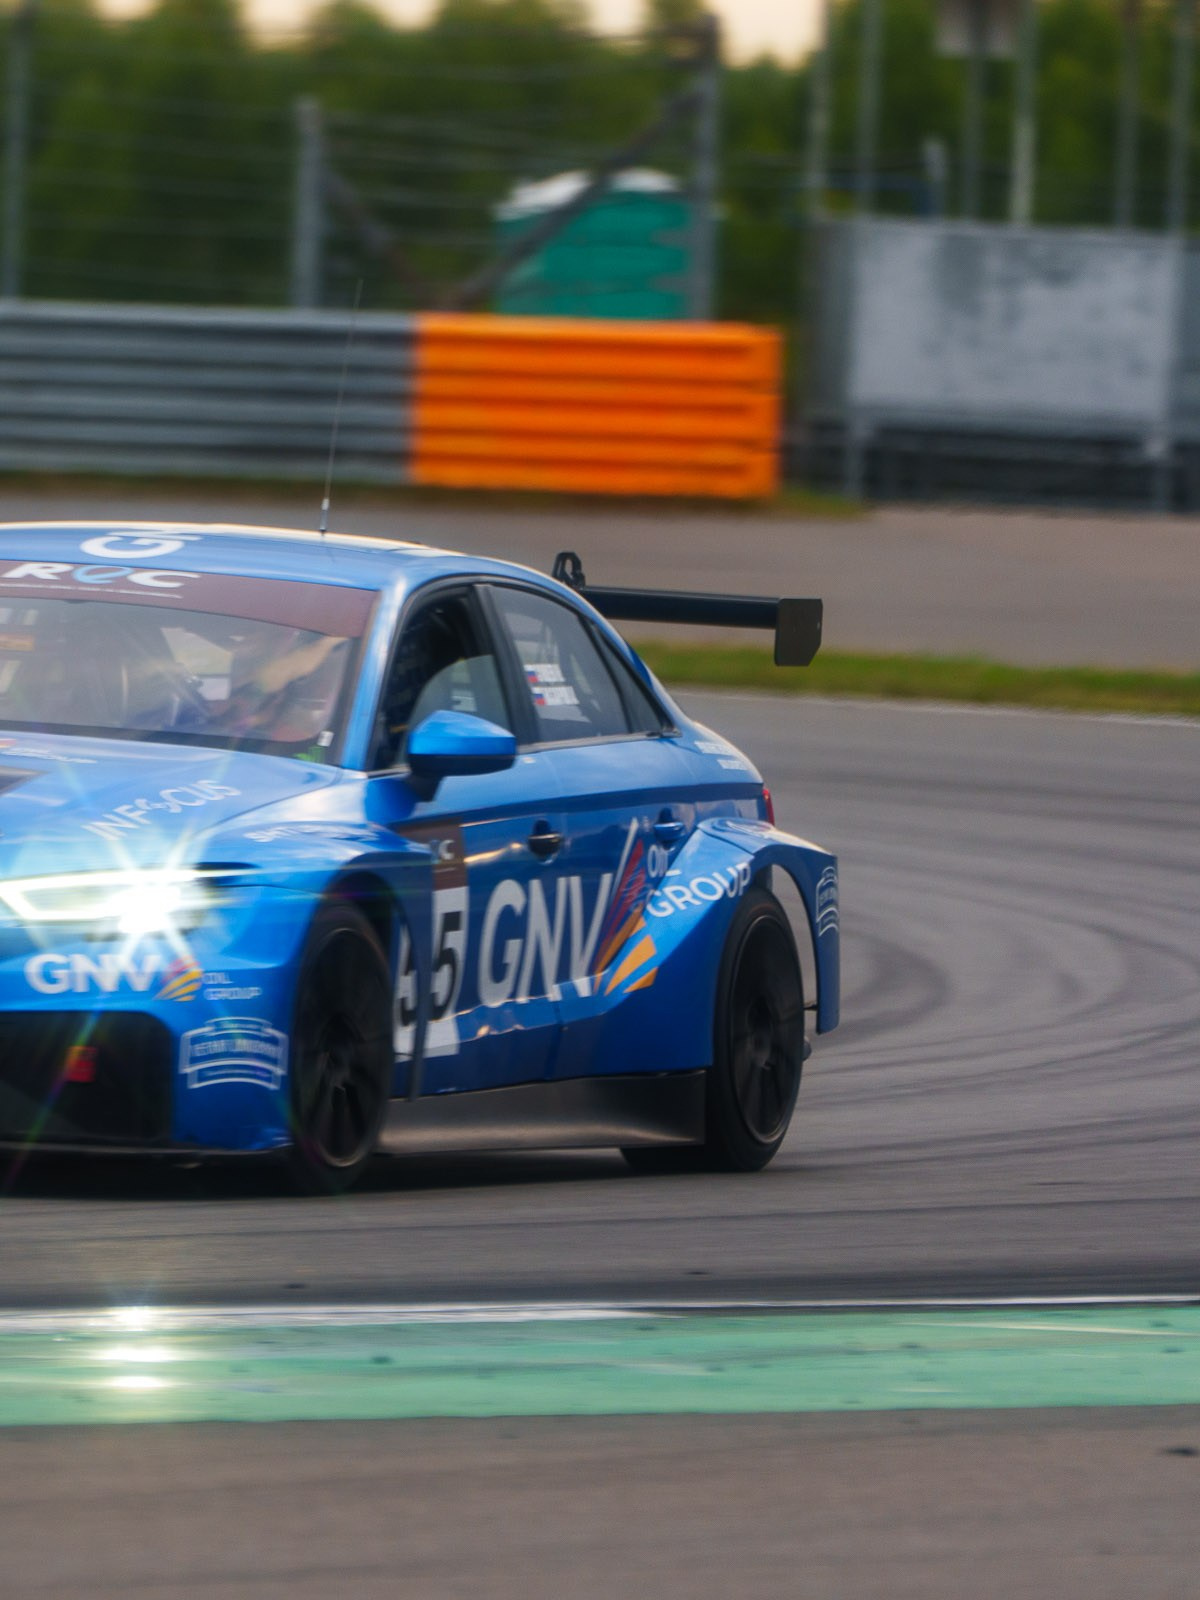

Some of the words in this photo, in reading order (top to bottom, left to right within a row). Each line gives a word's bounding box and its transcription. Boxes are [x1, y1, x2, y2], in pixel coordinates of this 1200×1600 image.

[646, 862, 751, 918] GROUP
[478, 872, 613, 1008] GNV
[23, 953, 161, 995] GNV
